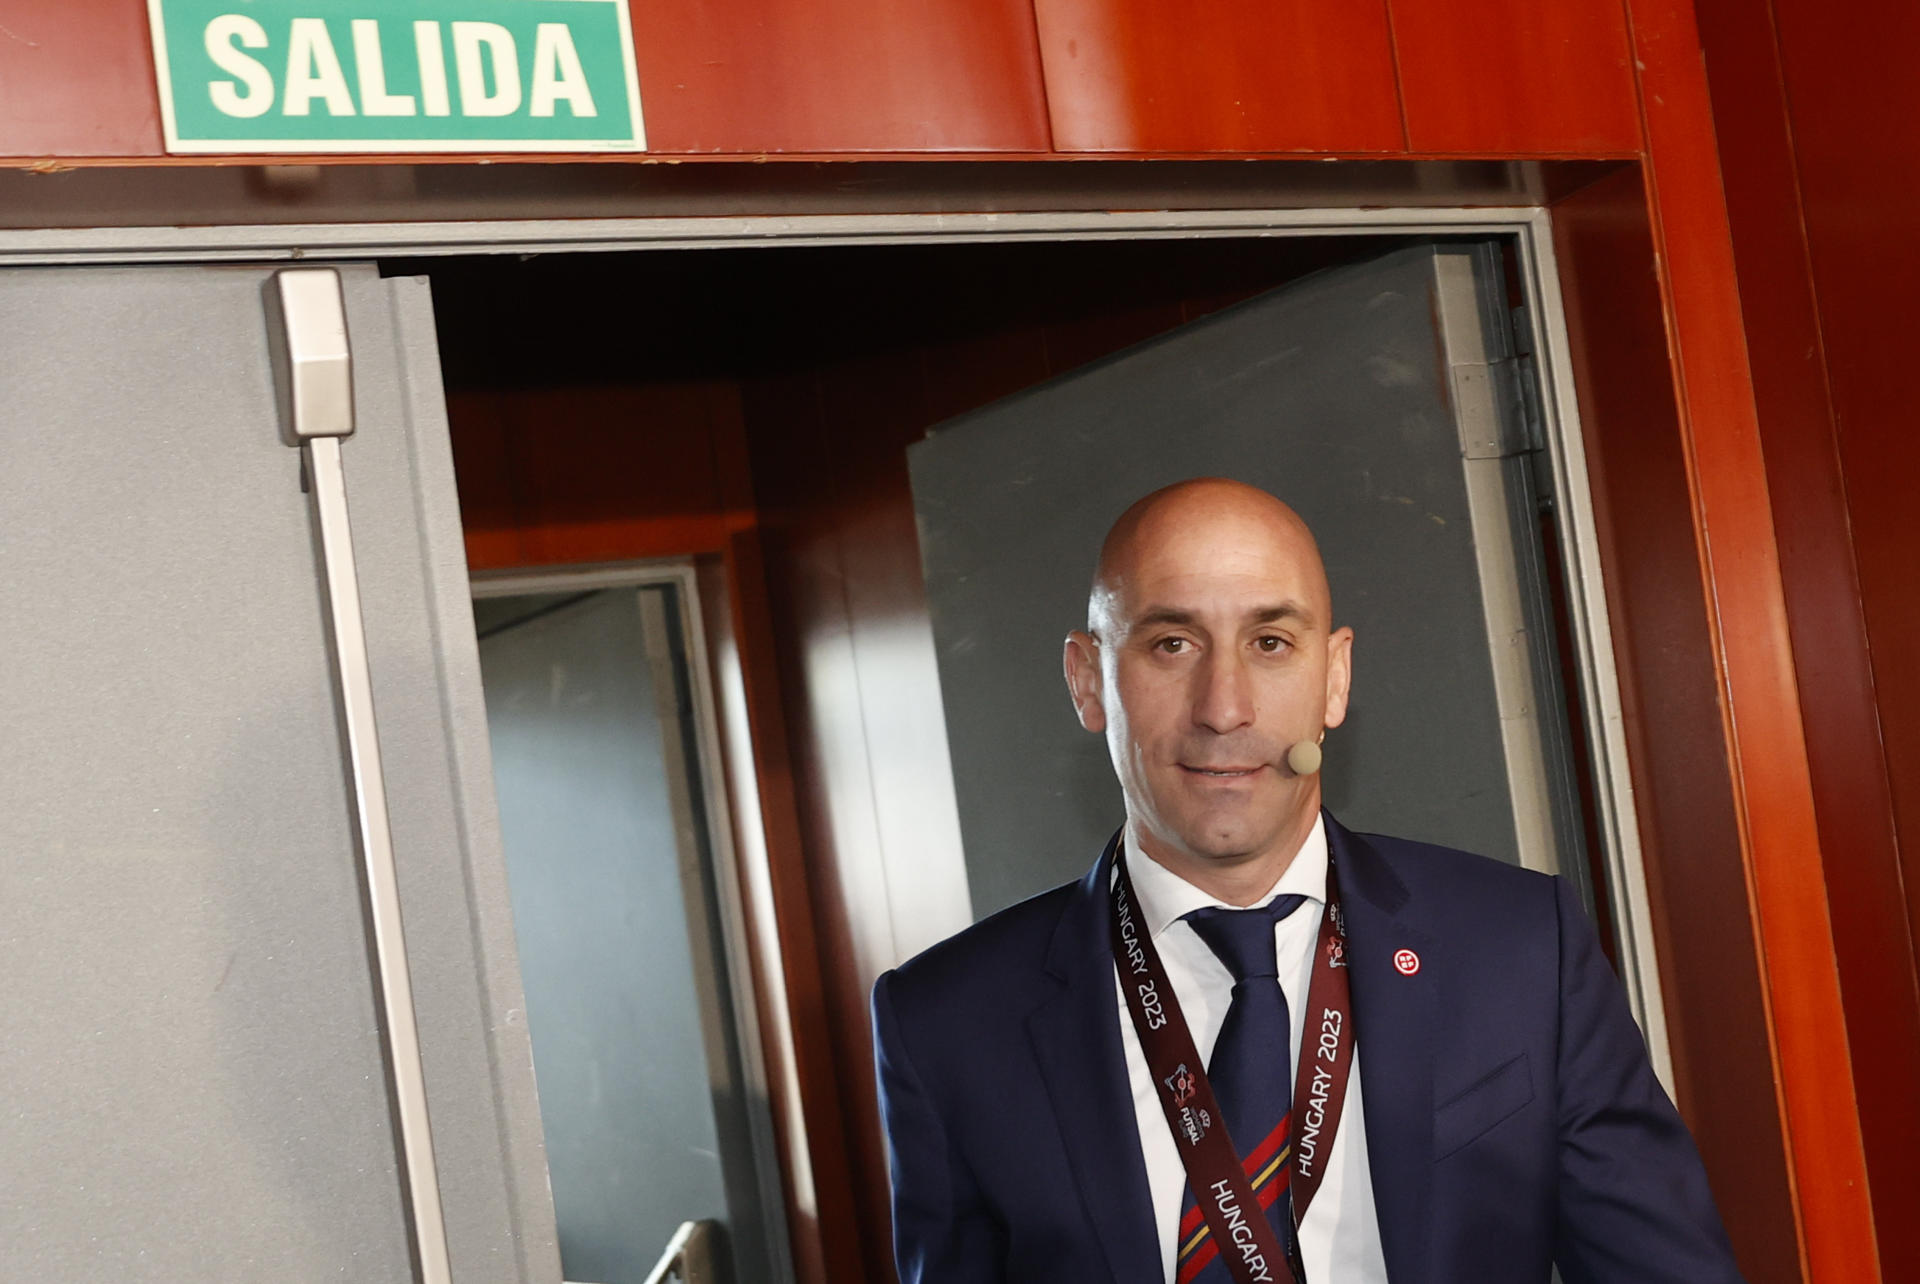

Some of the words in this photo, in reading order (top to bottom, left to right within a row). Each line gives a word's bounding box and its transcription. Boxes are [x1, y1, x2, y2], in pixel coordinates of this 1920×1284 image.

[204, 14, 598, 118] SALIDA
[1117, 881, 1148, 975] HUNGARY
[1138, 979, 1167, 1030] 2023
[1180, 1106, 1200, 1147] FUTSAL
[1299, 1065, 1332, 1177] HUNGARY
[1317, 1008, 1342, 1062] 2023
[1210, 1178, 1274, 1282] HUNGARY
